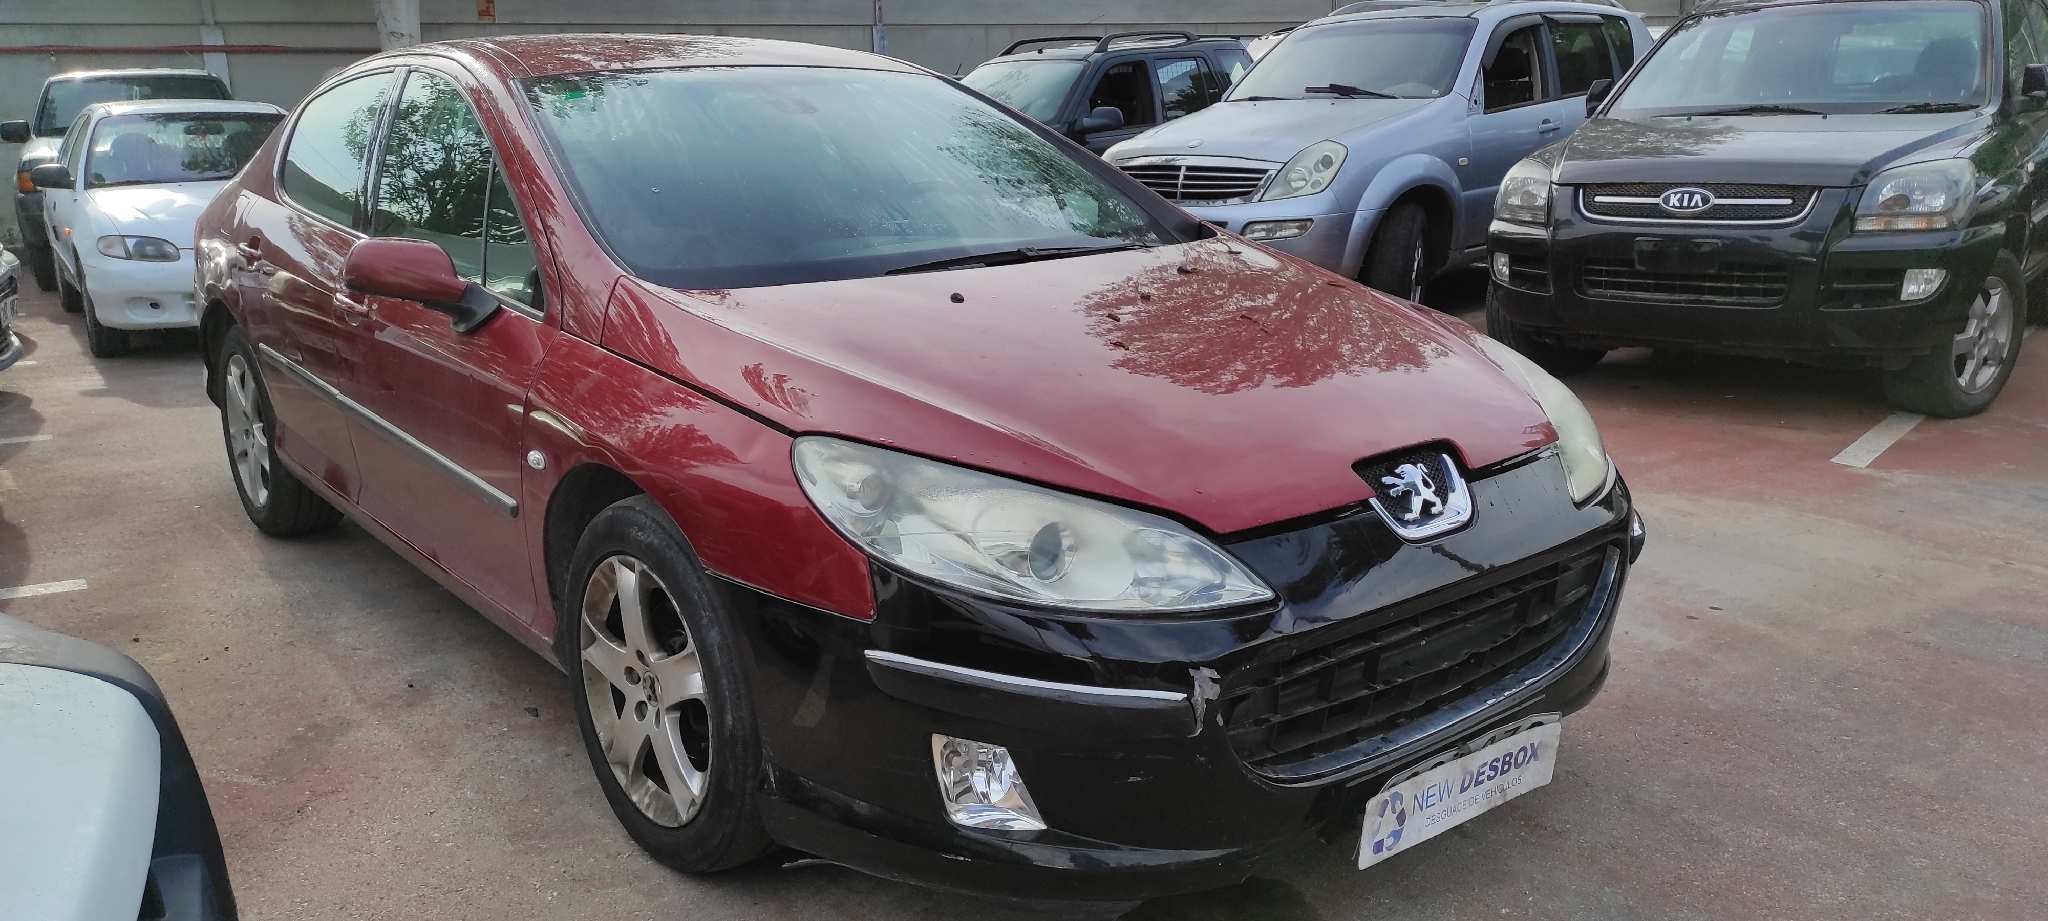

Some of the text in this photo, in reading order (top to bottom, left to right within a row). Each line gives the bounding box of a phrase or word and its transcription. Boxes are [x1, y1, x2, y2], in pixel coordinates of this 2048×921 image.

[1669, 193, 1703, 207] KIA
[1412, 778, 1455, 815] NEW
[1459, 742, 1541, 794] DESBOX
